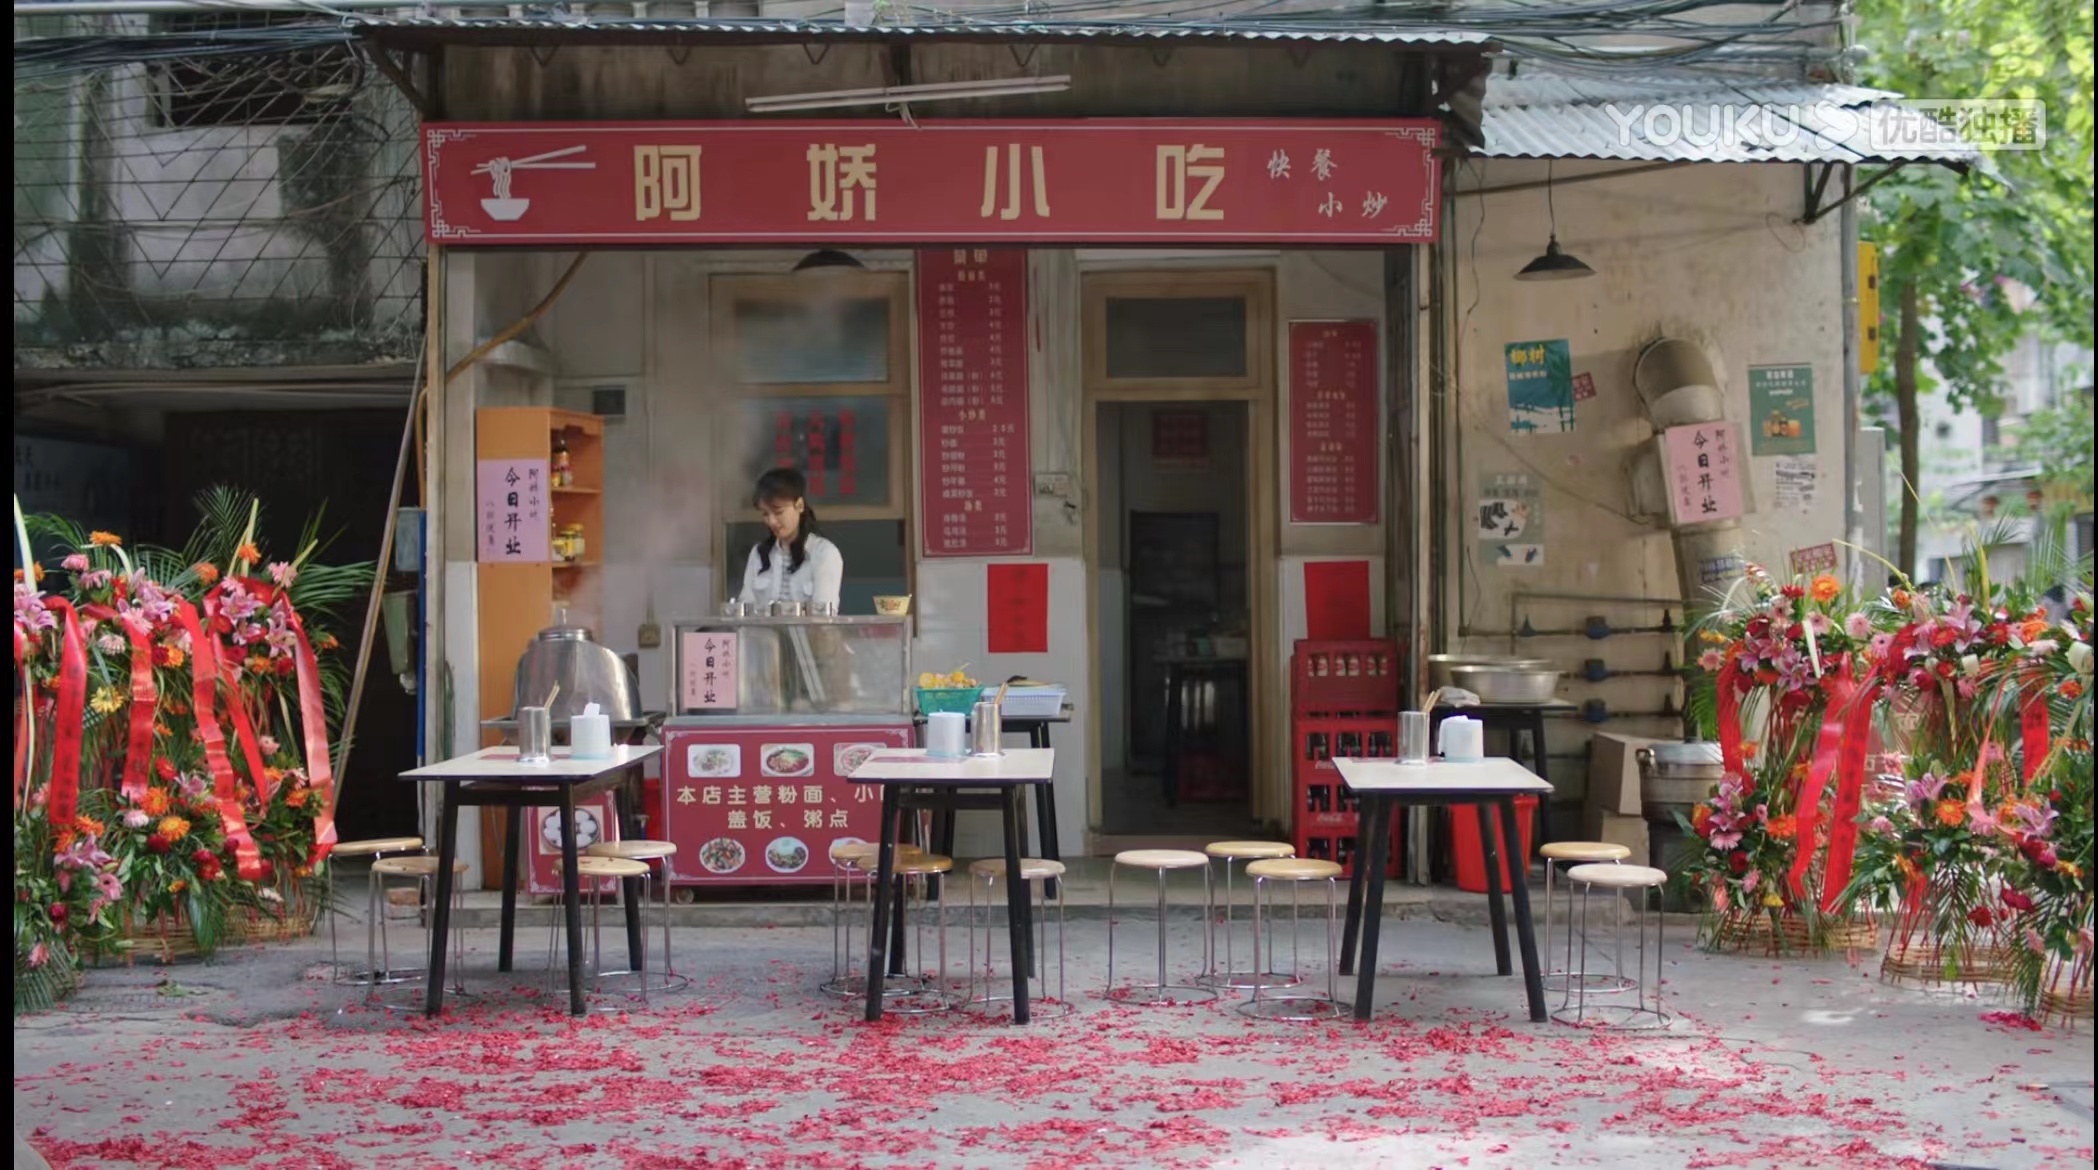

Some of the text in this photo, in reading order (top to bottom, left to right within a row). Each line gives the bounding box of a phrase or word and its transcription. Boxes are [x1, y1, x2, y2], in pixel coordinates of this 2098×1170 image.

[633, 143, 1225, 221] 阿娇小吃
[1266, 148, 1338, 180] 快餐
[1318, 190, 1388, 219] 小炒
[1693, 430, 1718, 514] 今日开业
[504, 466, 522, 555] 今日开业
[704, 636, 717, 703] 今日开业
[676, 784, 885, 805] 本店主营粉面、小
[727, 809, 849, 830] 盖饭、粥点
